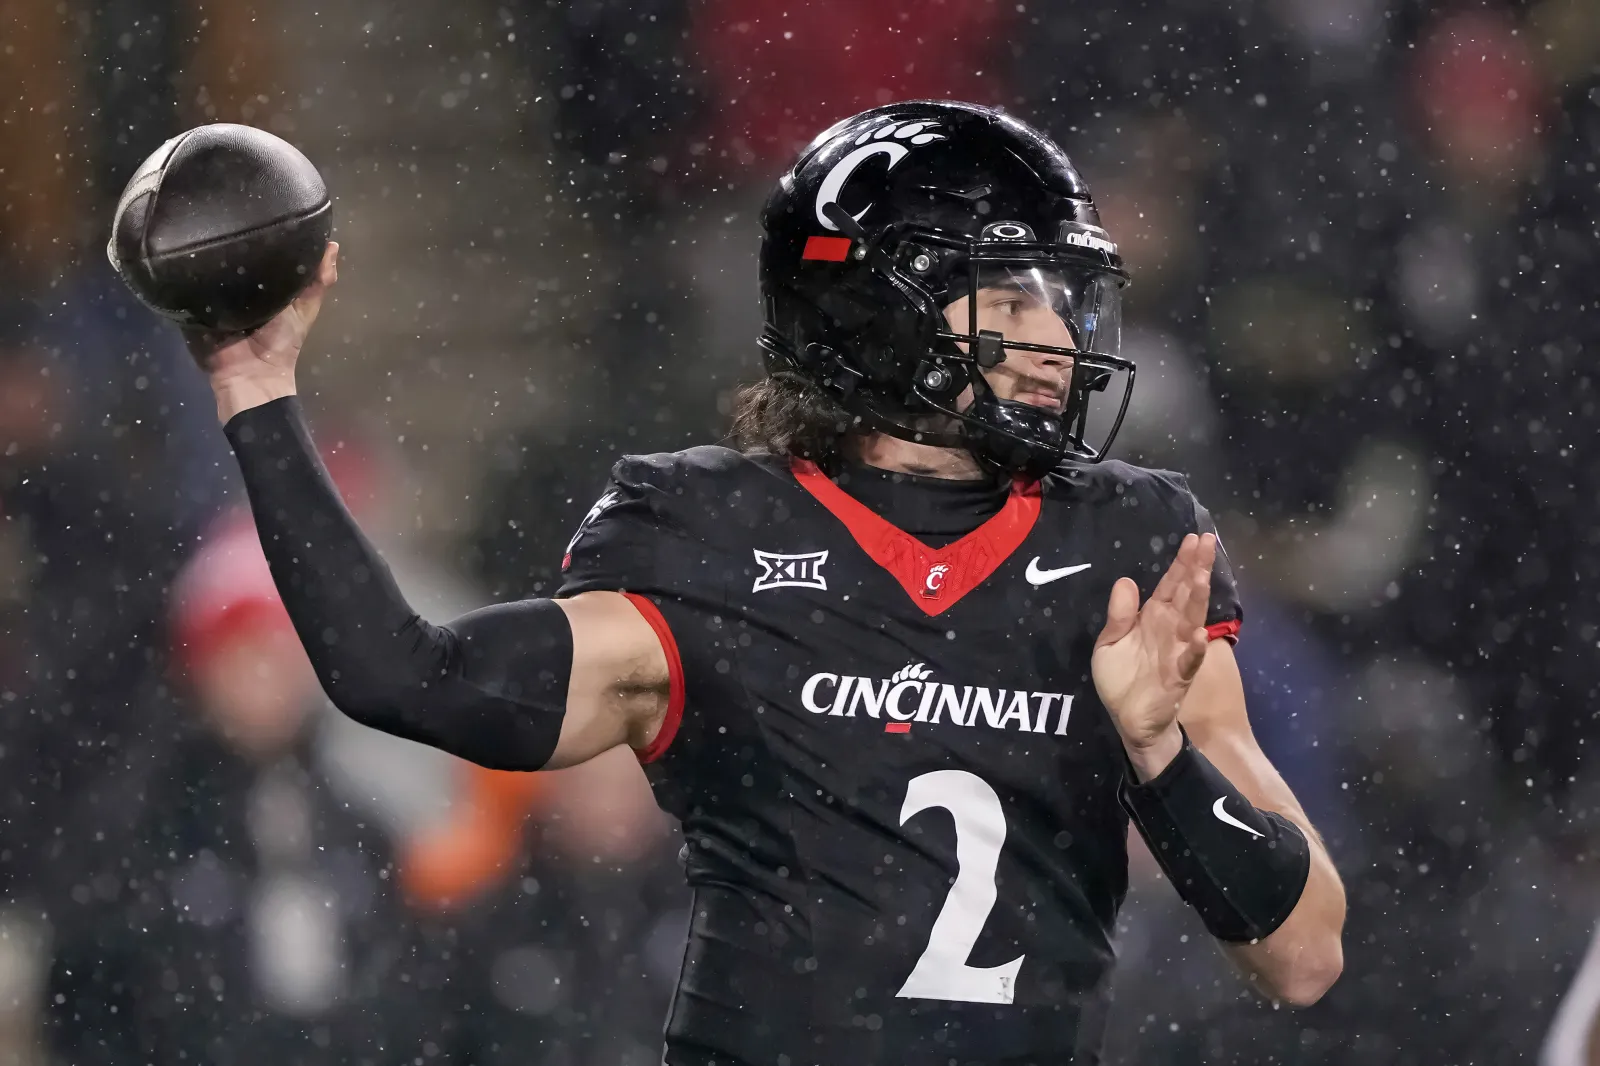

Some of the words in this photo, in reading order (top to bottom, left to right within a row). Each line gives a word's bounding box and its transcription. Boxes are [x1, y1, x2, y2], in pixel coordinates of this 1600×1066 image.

[816, 141, 909, 231] C
[755, 553, 826, 590] XII
[926, 570, 944, 590] C
[801, 670, 1075, 736] CINCINNATI
[895, 769, 1025, 1004] 2
